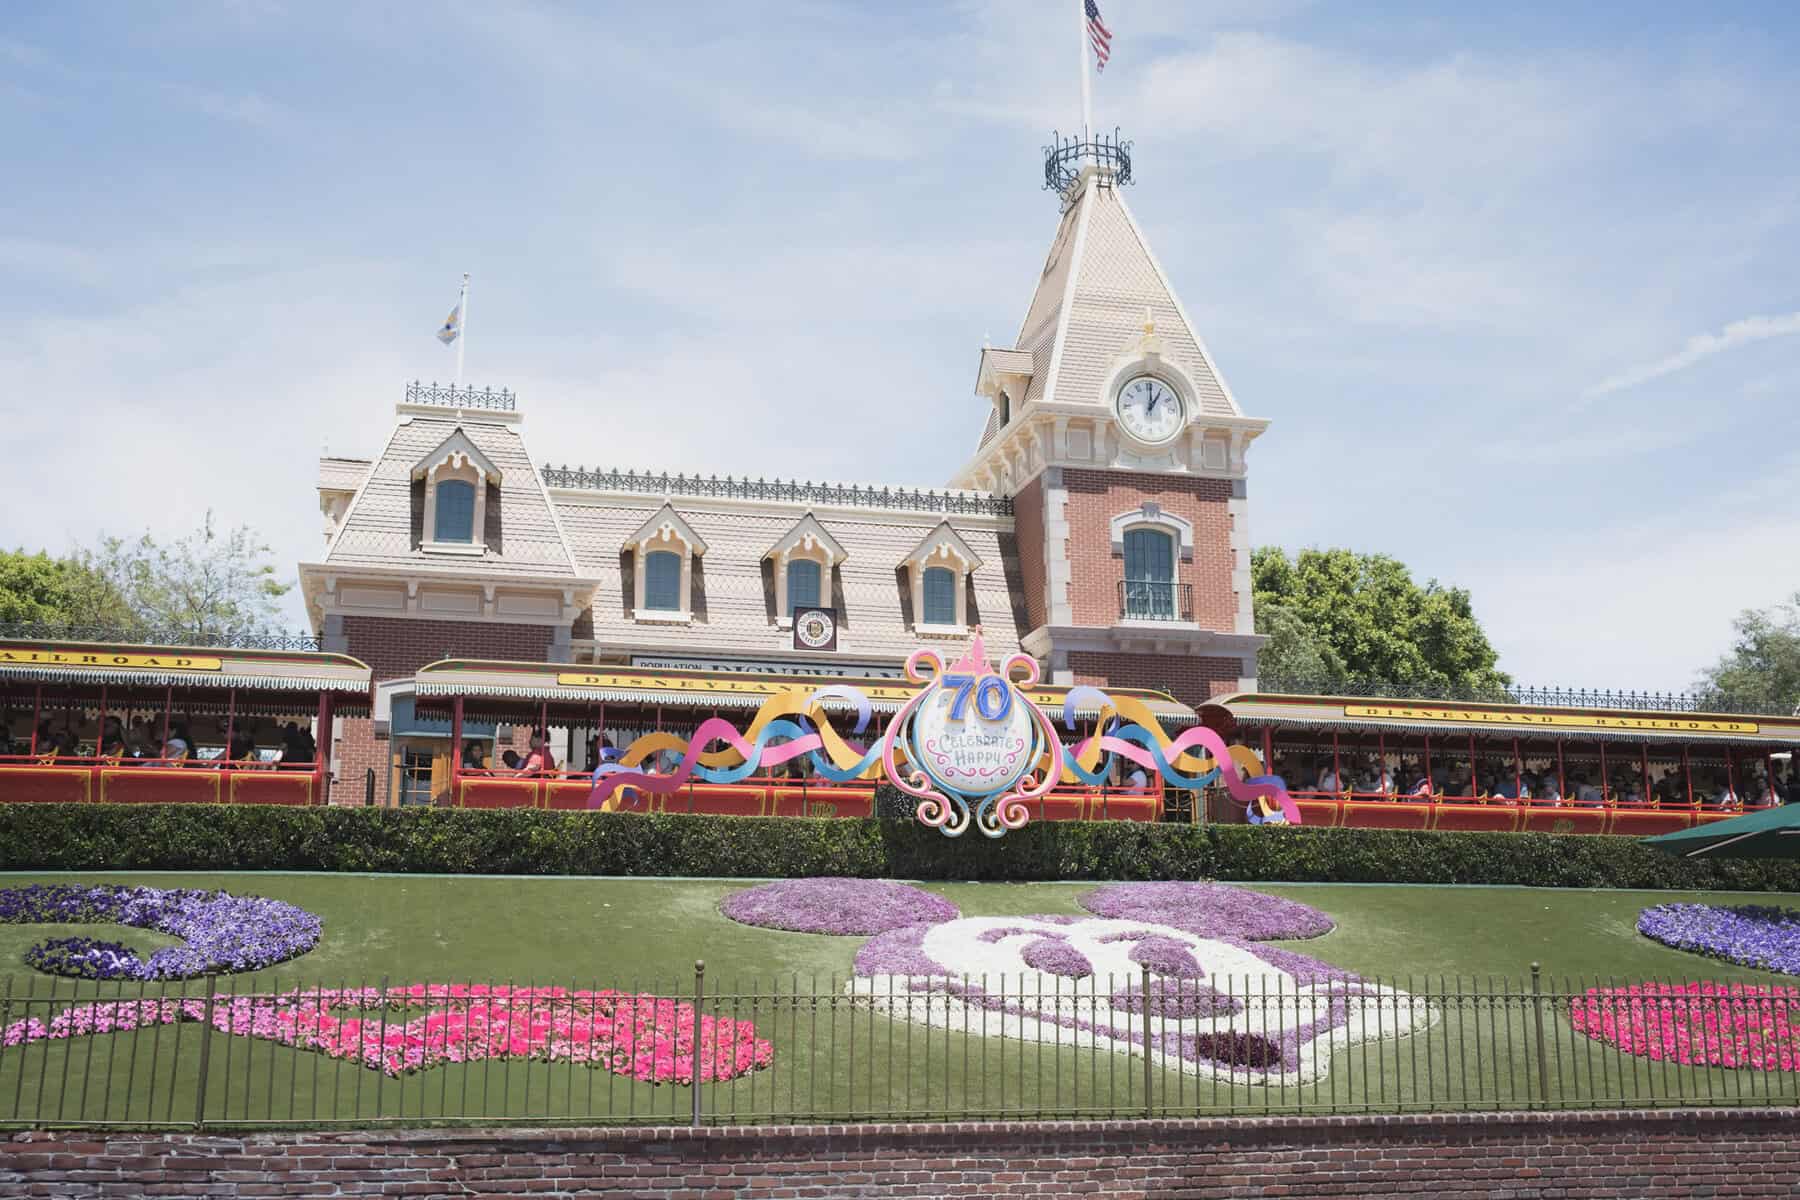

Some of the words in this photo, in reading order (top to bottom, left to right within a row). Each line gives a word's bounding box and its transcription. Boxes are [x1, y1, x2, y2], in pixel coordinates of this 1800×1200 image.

[585, 676, 818, 692] DISNEYLAND
[941, 674, 1011, 721] 70
[1367, 708, 1553, 723] DISNEYLAND
[1596, 719, 1741, 731] RAILROAD
